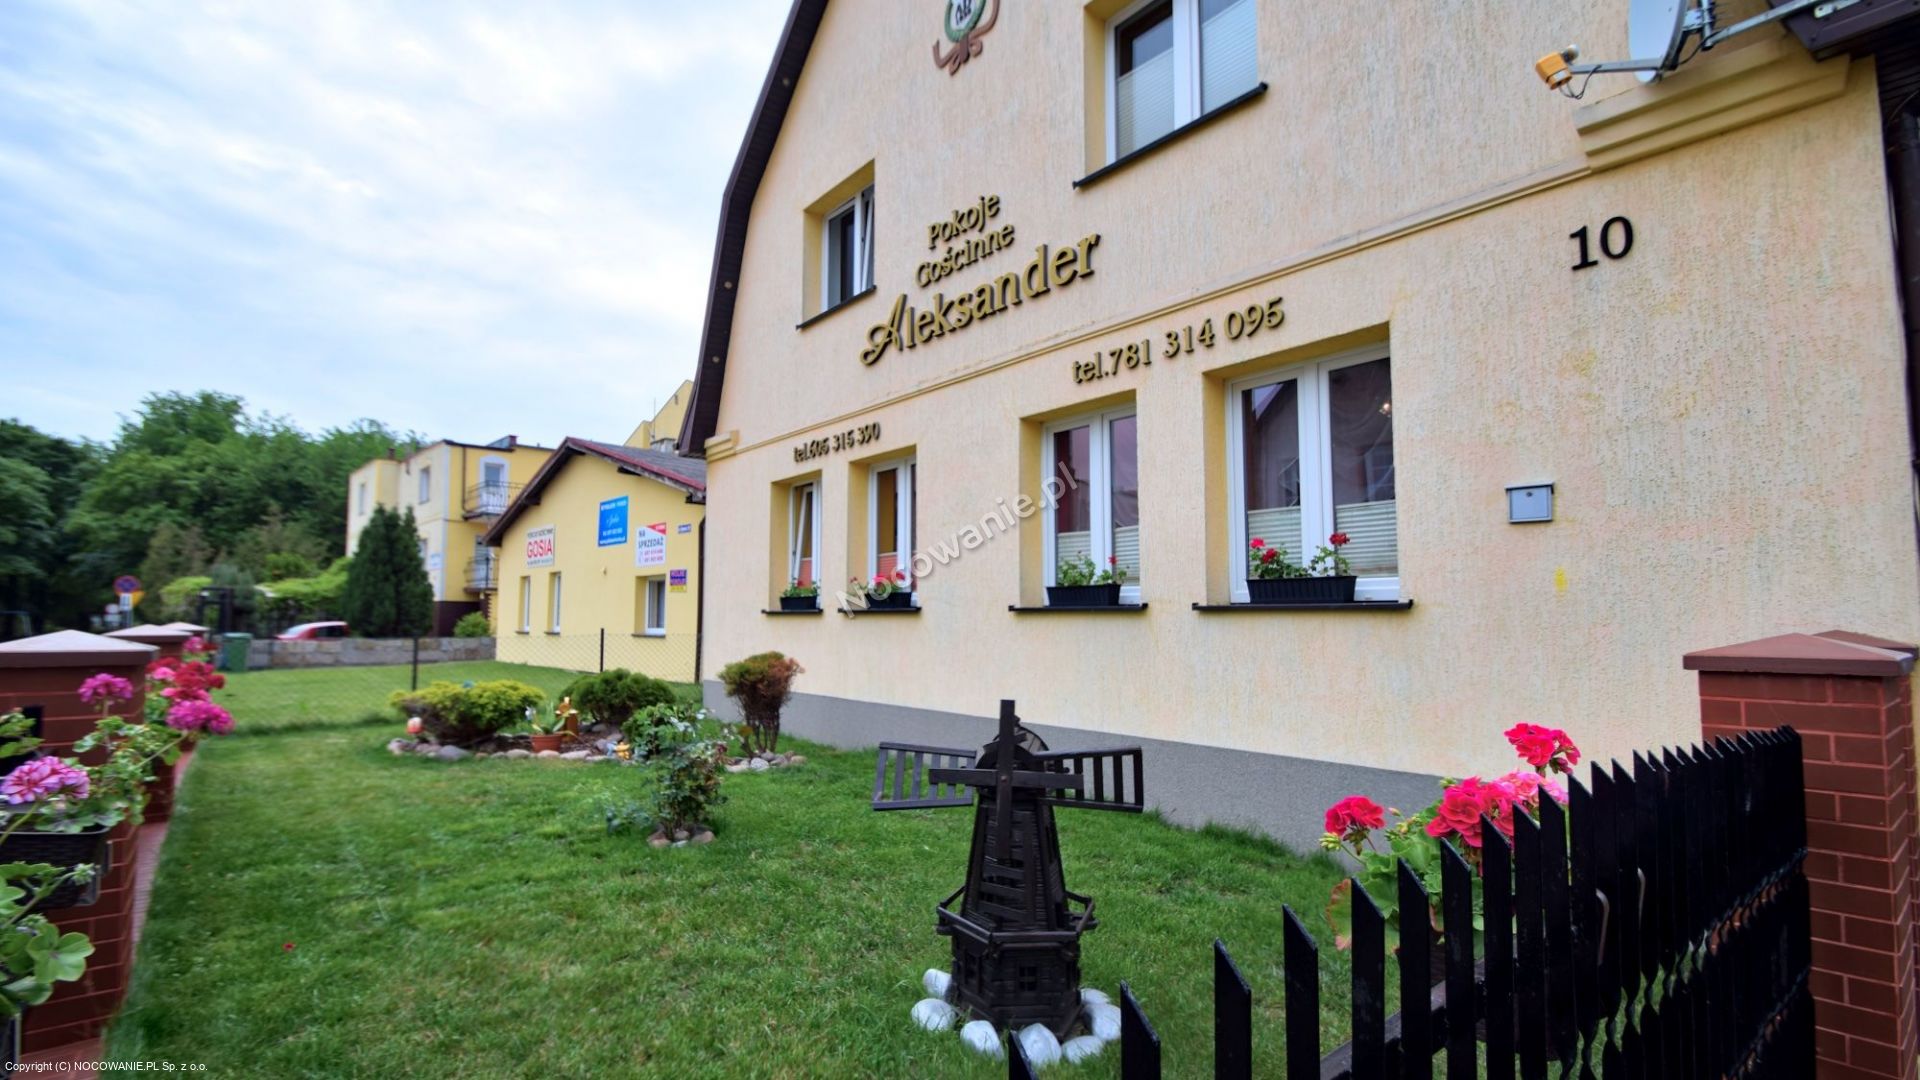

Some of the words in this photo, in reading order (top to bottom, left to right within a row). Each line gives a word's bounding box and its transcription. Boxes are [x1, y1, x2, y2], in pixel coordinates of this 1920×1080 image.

[927, 194, 1000, 250] Pokoje
[1569, 215, 1633, 272] 10
[915, 223, 1015, 288] Gościnne
[860, 232, 1101, 366] Aleksander
[1072, 338, 1152, 384] tel.781
[1163, 317, 1216, 359] 314
[1223, 296, 1285, 341] 095
[832, 429, 855, 453] 315
[857, 421, 882, 446] 390
[527, 538, 553, 559] GOSIA
